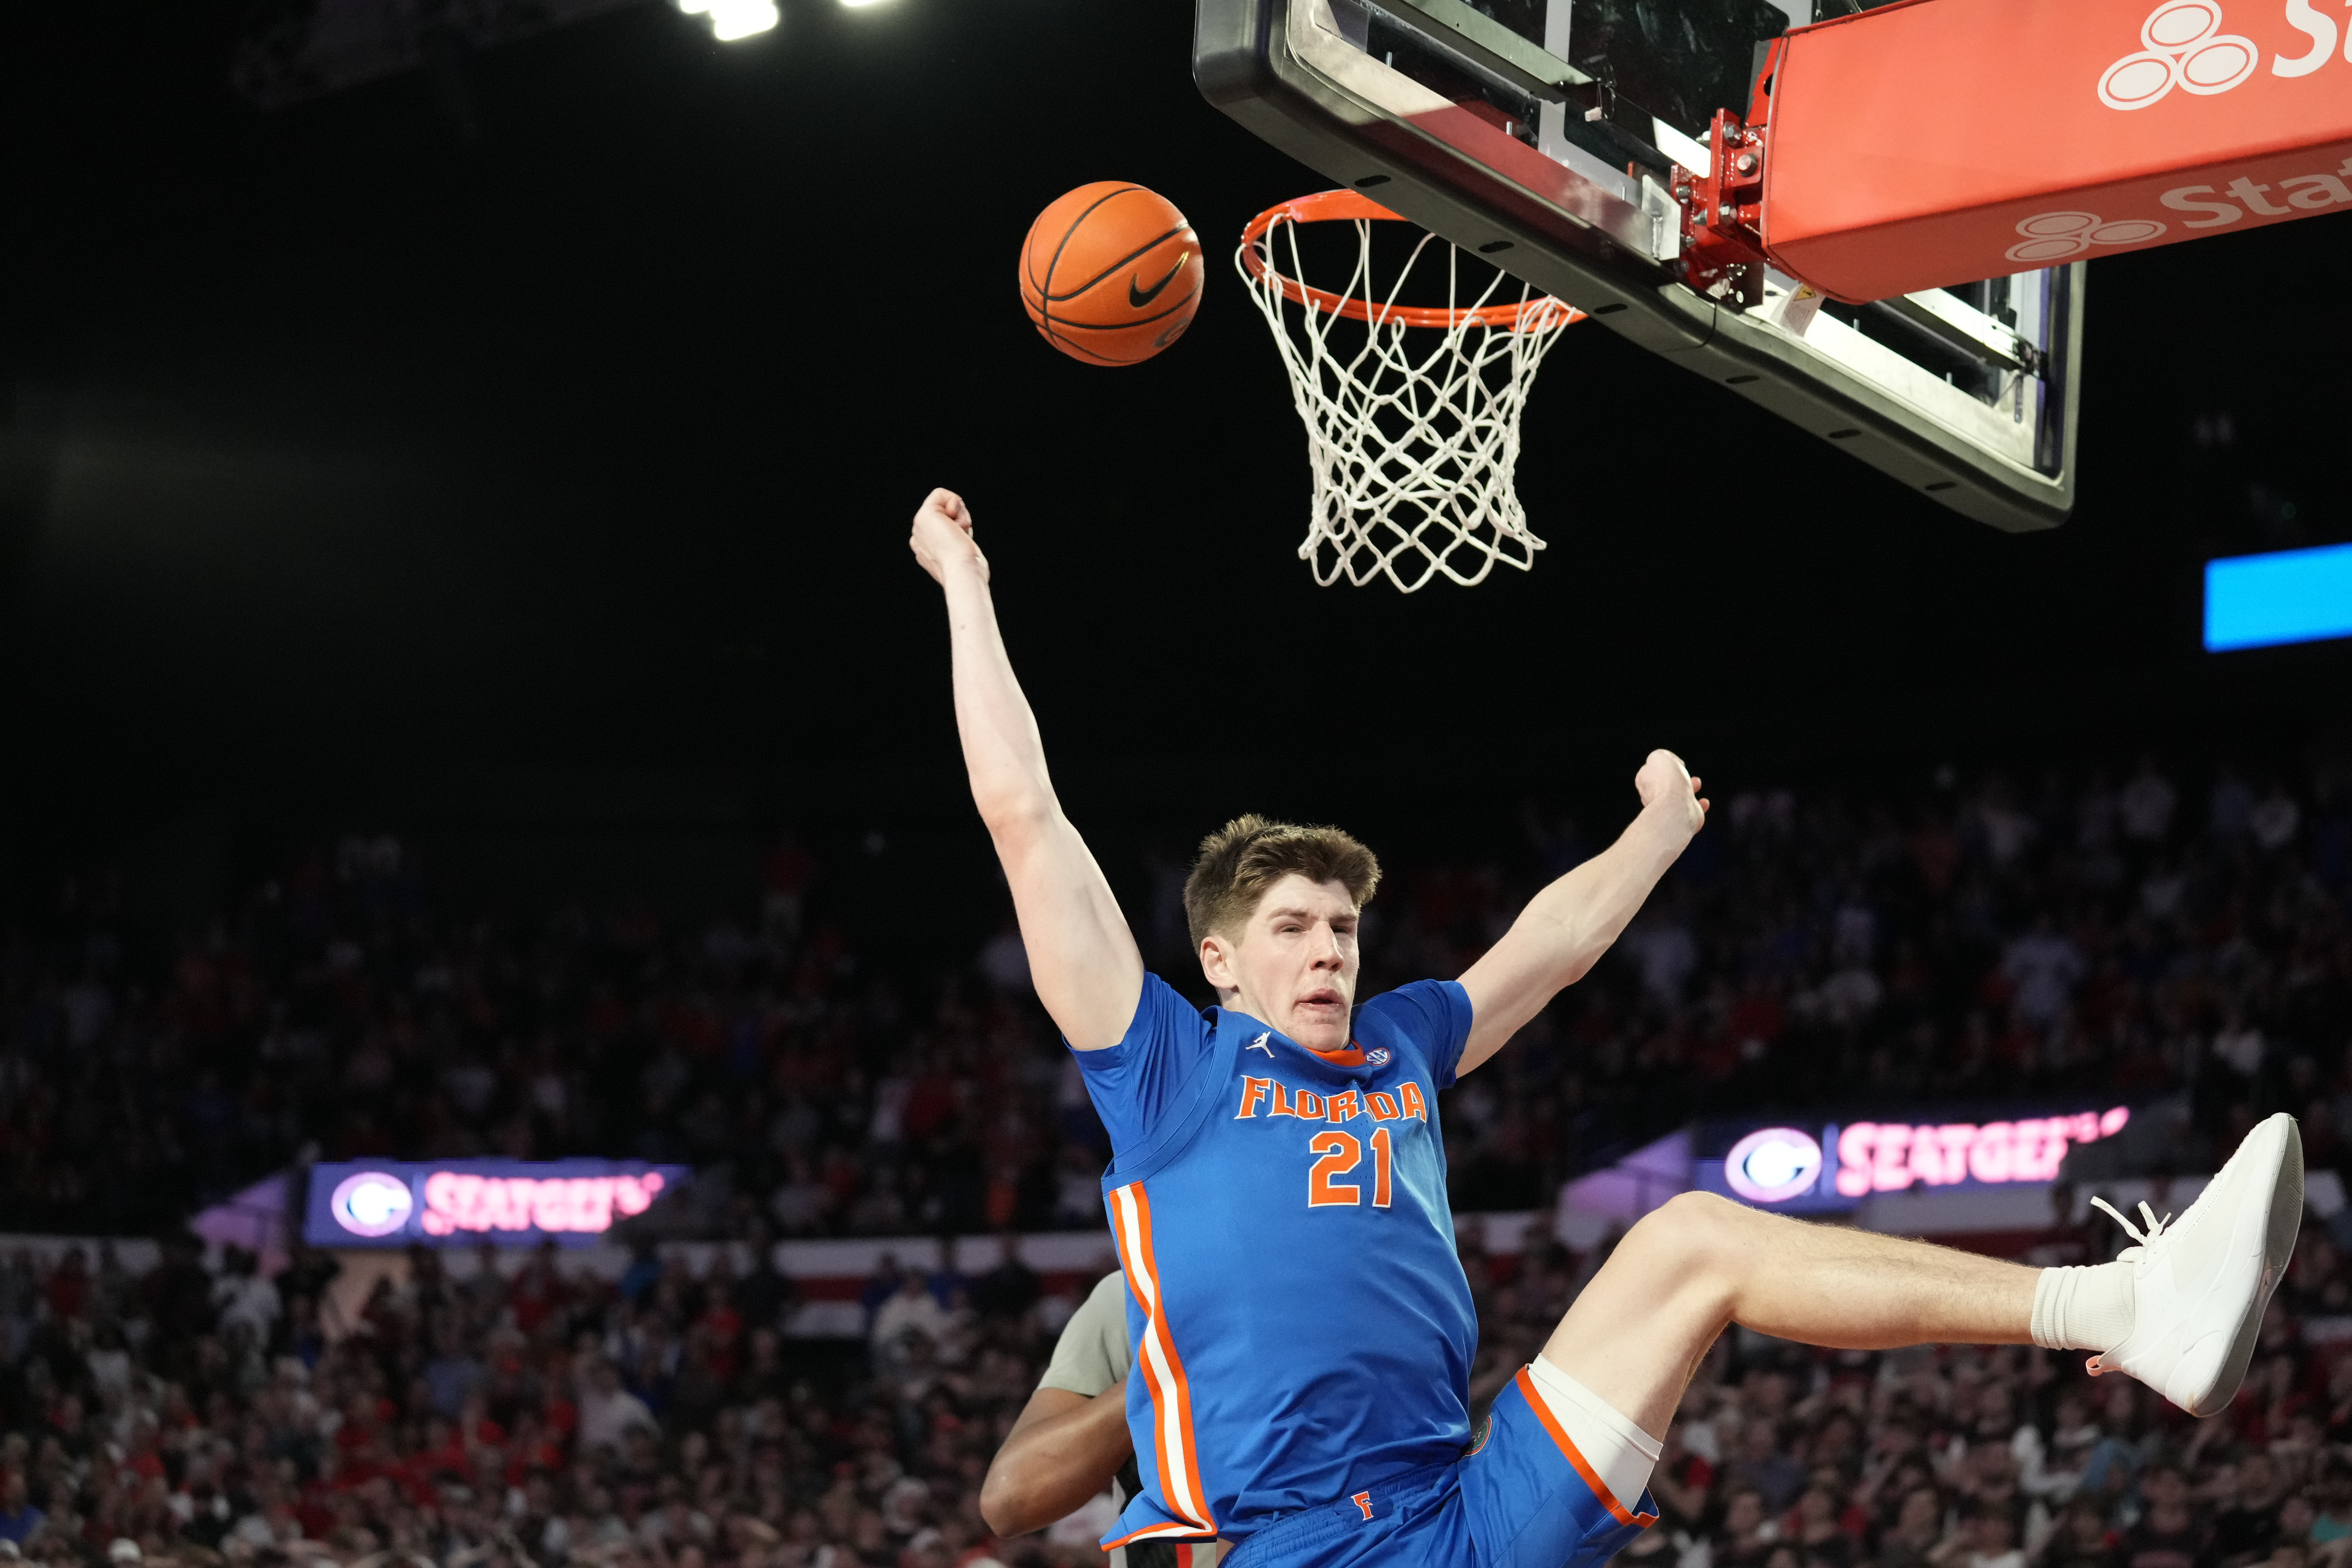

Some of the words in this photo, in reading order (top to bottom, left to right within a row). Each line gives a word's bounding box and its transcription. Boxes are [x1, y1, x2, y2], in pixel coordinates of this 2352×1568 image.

[2272, 0, 2352, 77] S
[1366, 1049, 1388, 1065] SEC
[1234, 1075, 1427, 1123] FLORDA
[1308, 1127, 1392, 1208] 21
[1350, 1491, 1374, 1521] F
